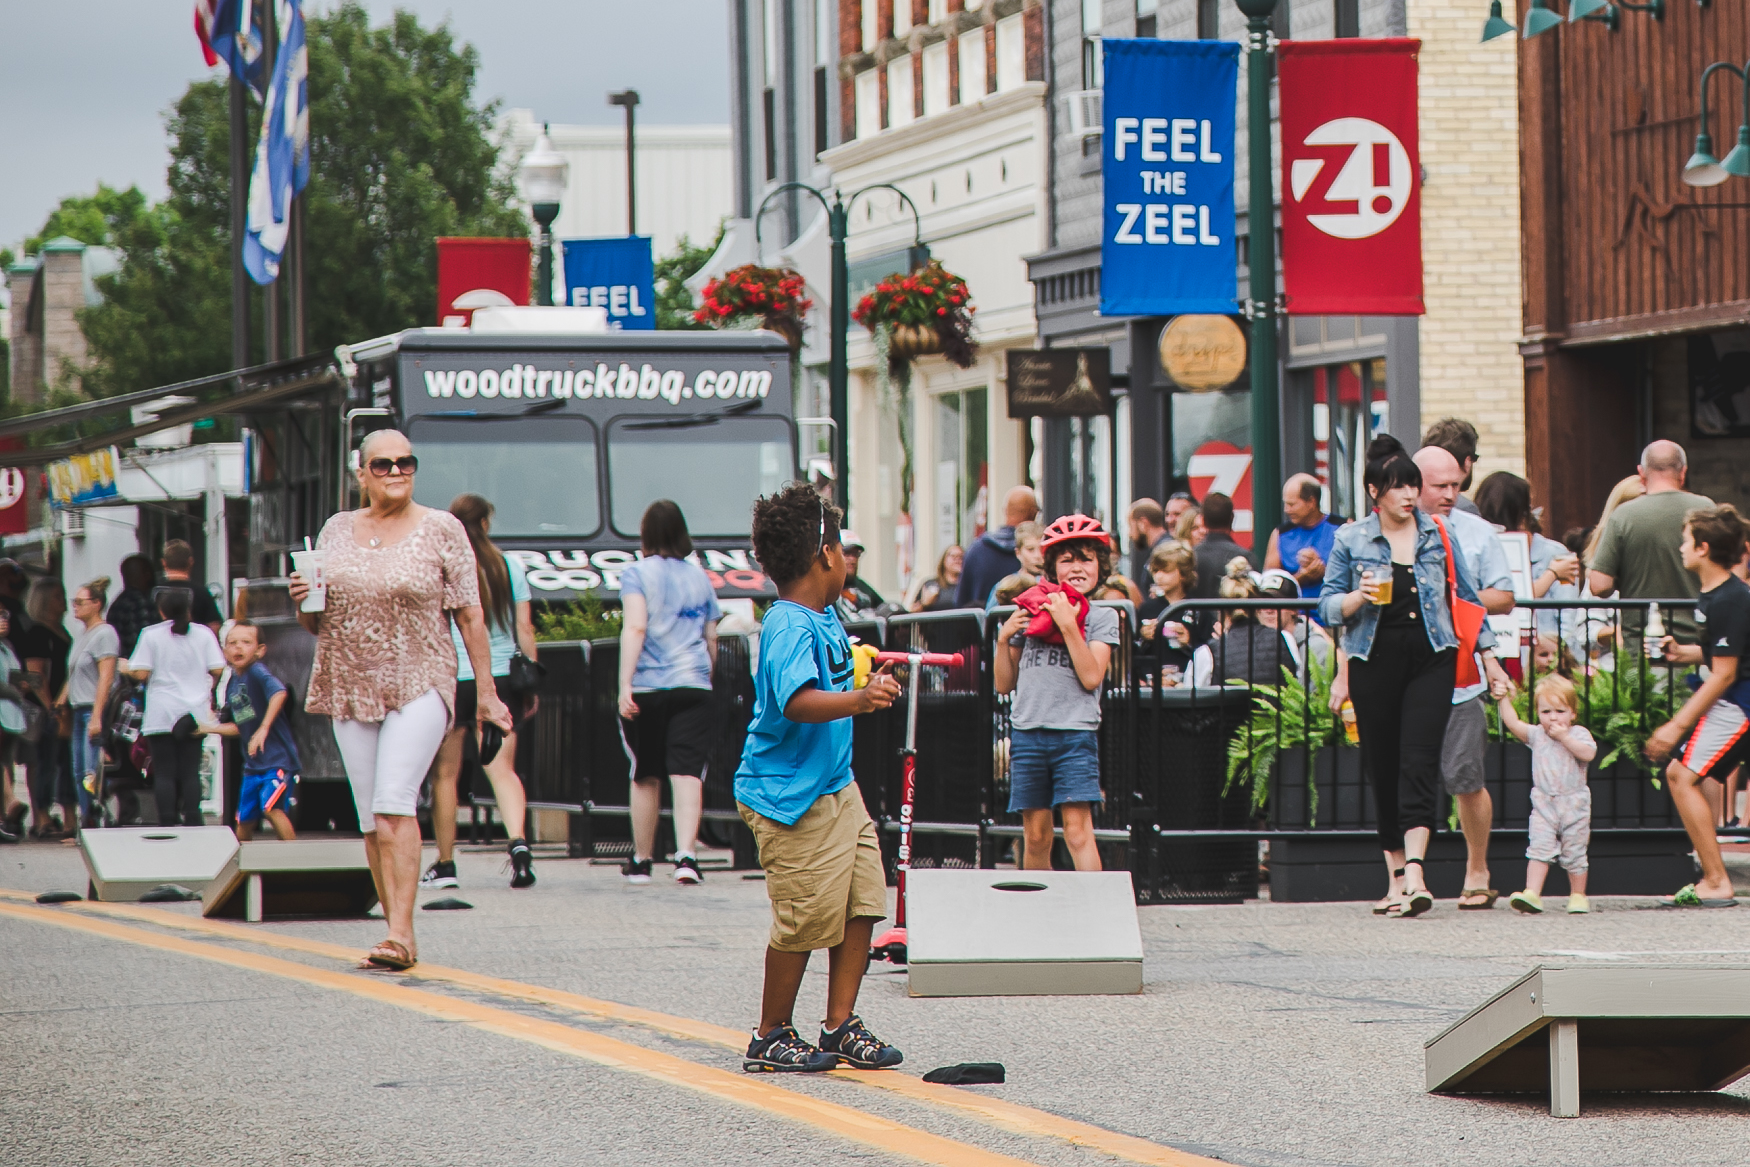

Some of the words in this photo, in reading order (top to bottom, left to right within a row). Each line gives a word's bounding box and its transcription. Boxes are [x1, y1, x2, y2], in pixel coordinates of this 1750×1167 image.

[1114, 117, 1222, 163] FEEL
[1140, 170, 1186, 195] THE
[1114, 203, 1220, 246] ZEEL
[424, 363, 772, 405] woodtruckbbq.com
